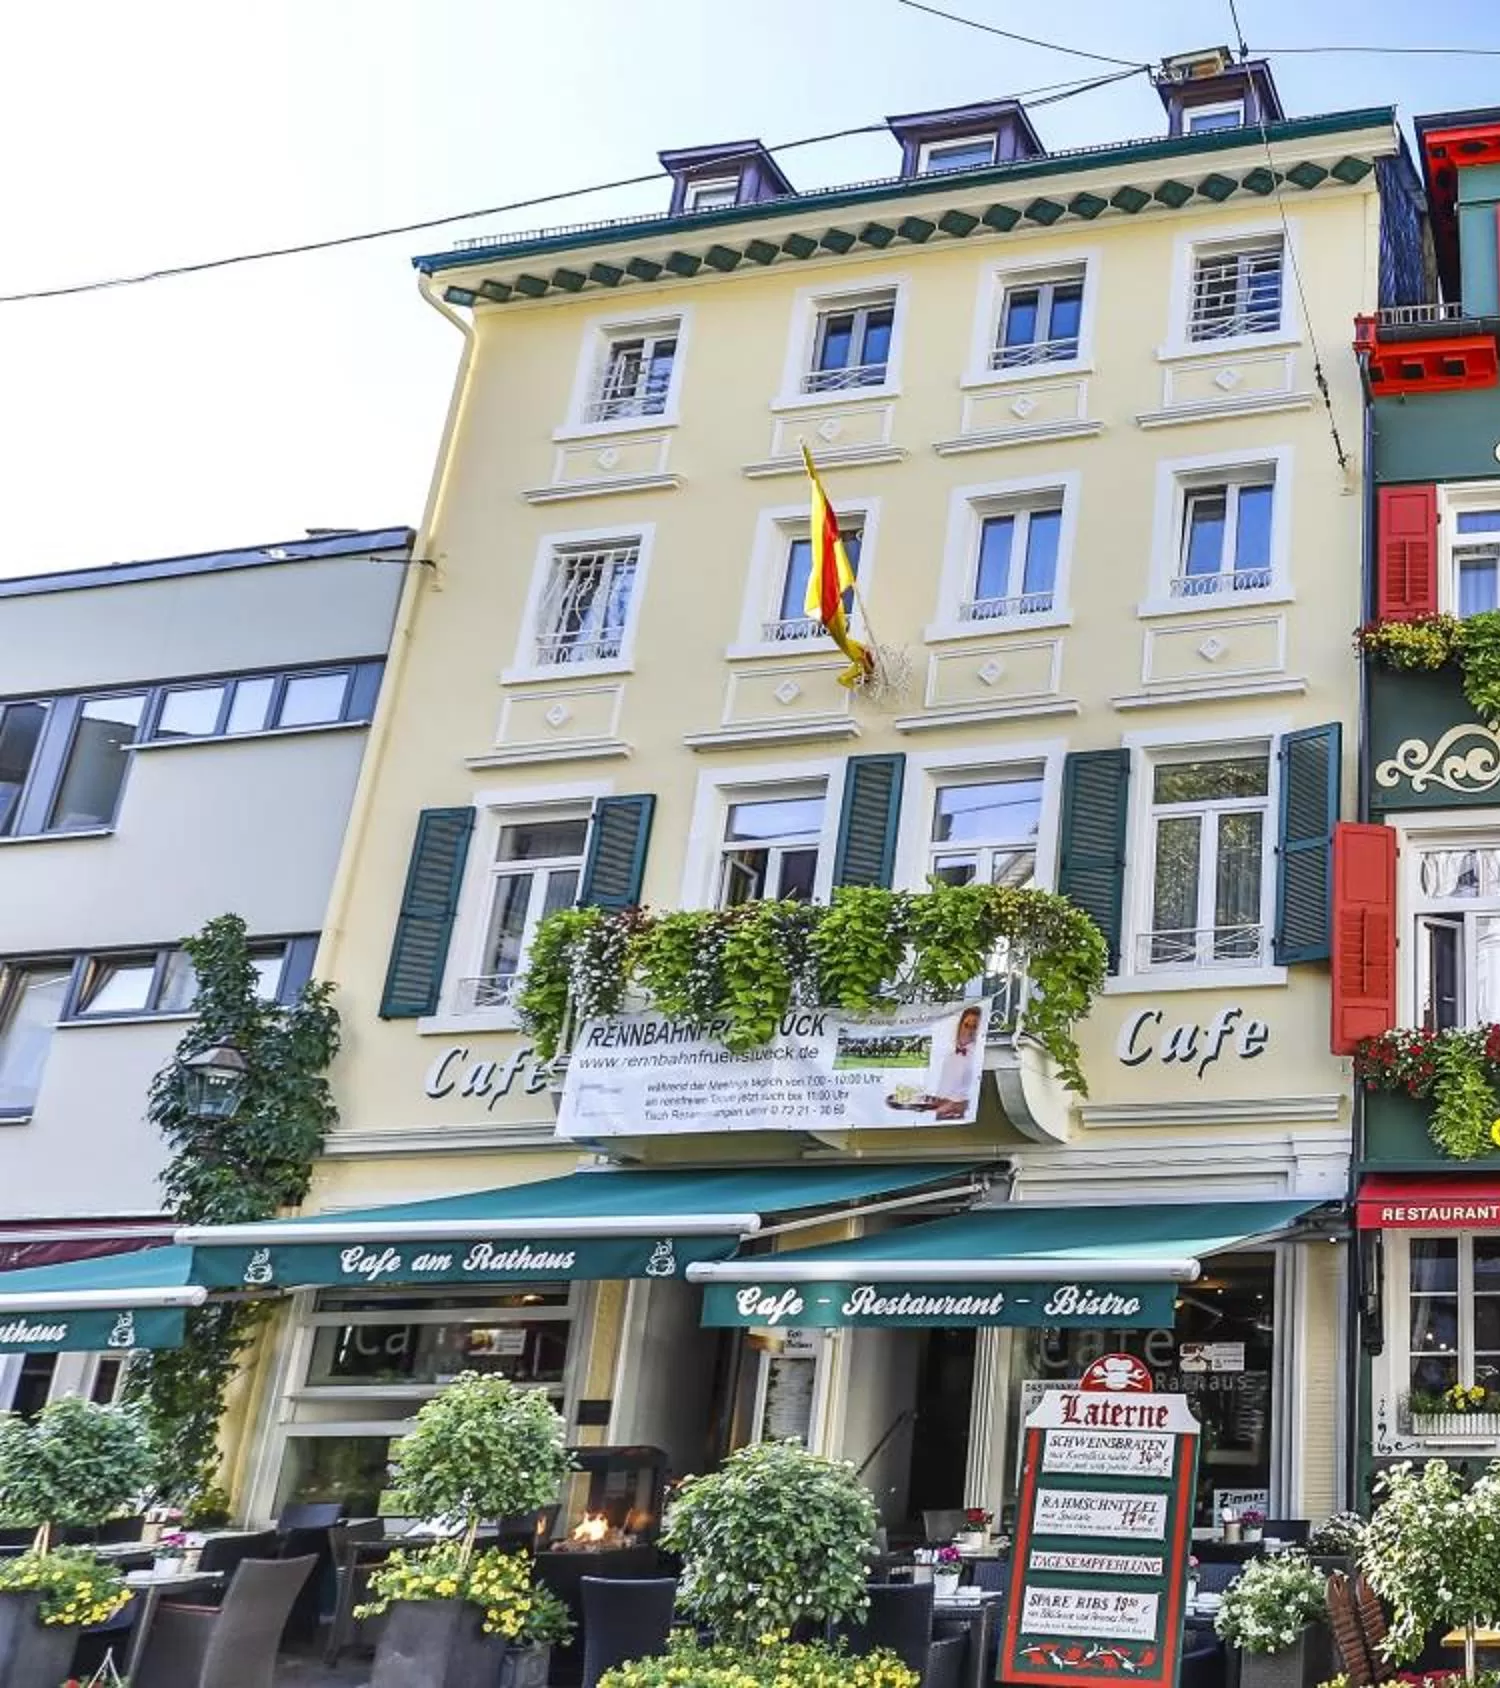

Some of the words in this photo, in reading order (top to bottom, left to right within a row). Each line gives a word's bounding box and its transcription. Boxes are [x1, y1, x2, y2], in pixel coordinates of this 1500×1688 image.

[586, 1012, 828, 1048] RENNBAHNFRÜCK
[1116, 1007, 1269, 1080] Cafe
[1382, 1206, 1500, 1222] RESTAURANT
[340, 1246, 402, 1281] Cafe
[411, 1253, 453, 1272] am
[462, 1241, 577, 1272] Rathaus
[736, 1287, 805, 1324] Cafe
[842, 1285, 1004, 1317] Restaurant
[1044, 1284, 1141, 1316] Bistro
[1060, 1394, 1169, 1429] Laterne
[1041, 1495, 1160, 1513] RAHMSCHNITZEL
[1033, 1555, 1161, 1574] TAGESEMPFEHLUNG
